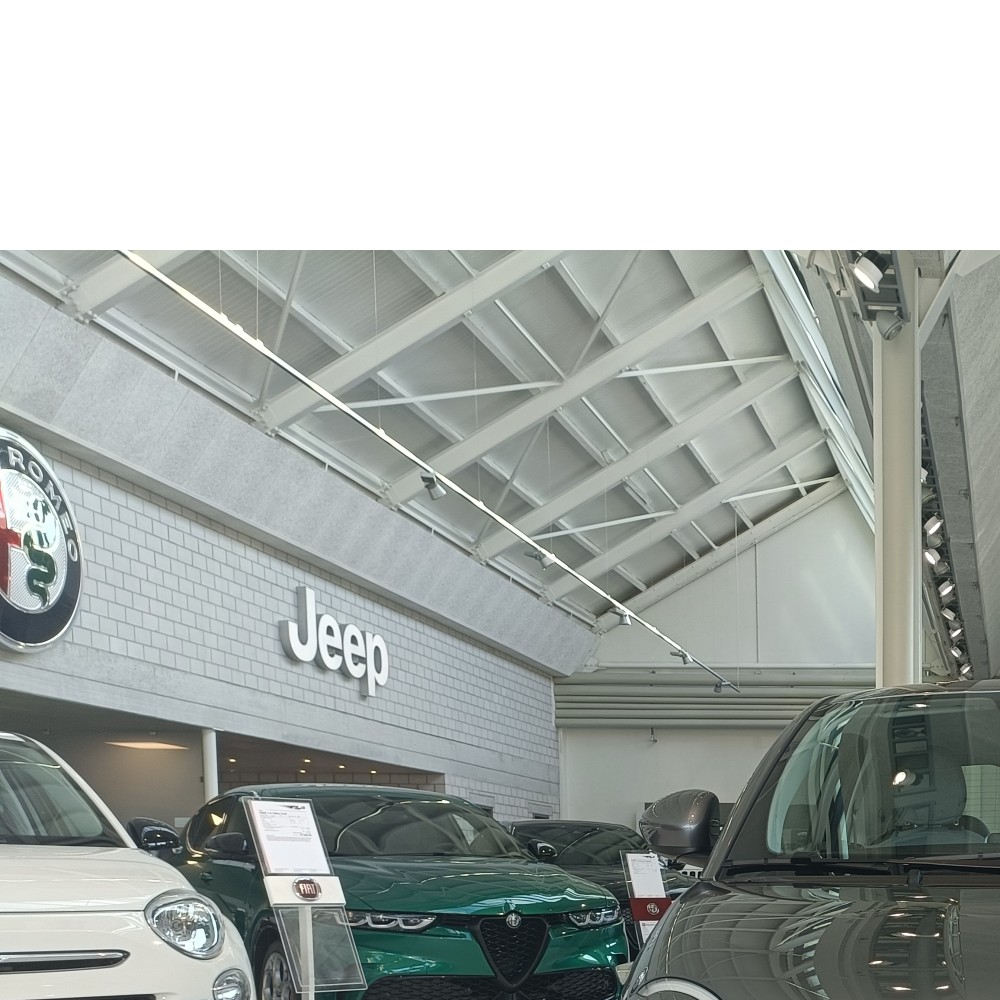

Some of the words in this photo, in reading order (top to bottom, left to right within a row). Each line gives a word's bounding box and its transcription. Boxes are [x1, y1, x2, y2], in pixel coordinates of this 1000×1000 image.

[7, 445, 78, 562] ROMEO
[281, 586, 389, 697] Jeep
[299, 883, 316, 895] FIAT
